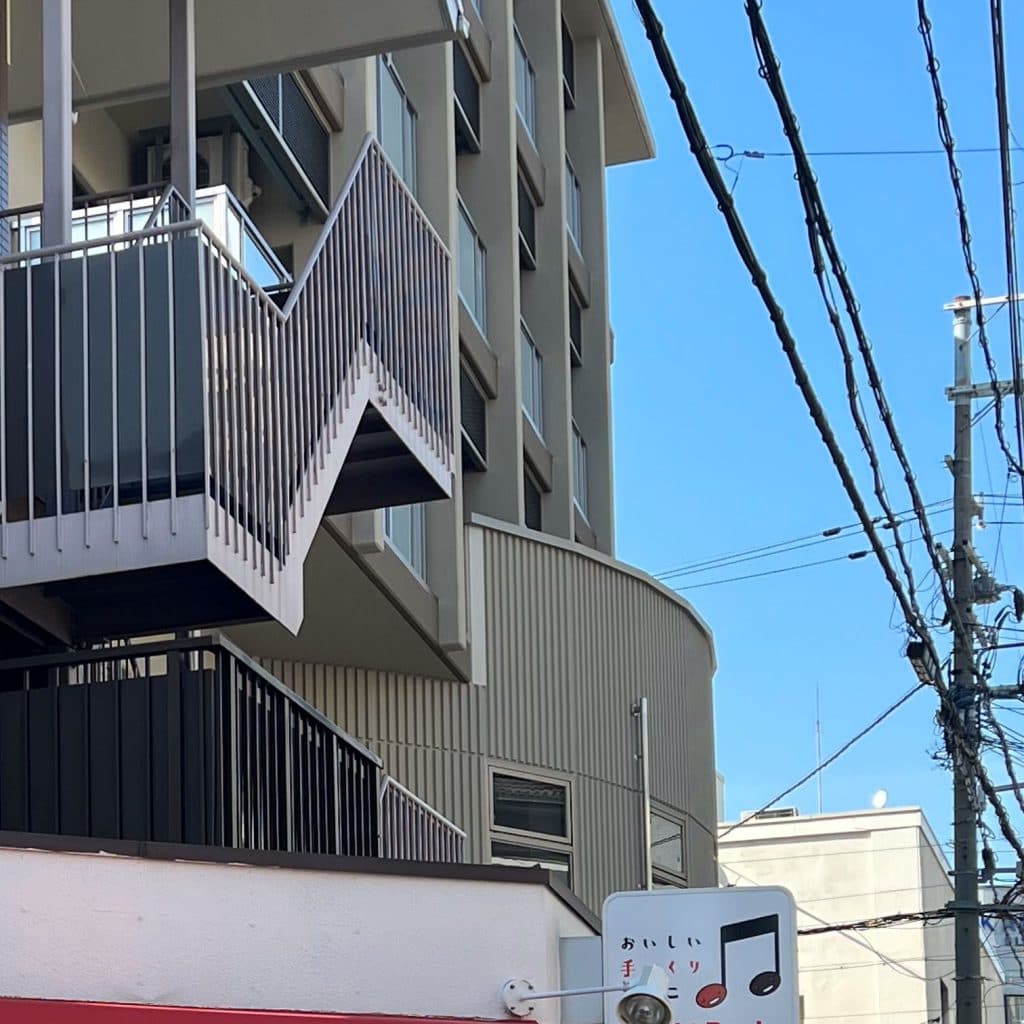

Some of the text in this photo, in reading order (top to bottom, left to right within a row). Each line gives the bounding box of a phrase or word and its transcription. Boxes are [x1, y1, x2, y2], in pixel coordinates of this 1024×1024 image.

[621, 935, 701, 950] おいしい
[621, 959, 700, 978] 手くり
